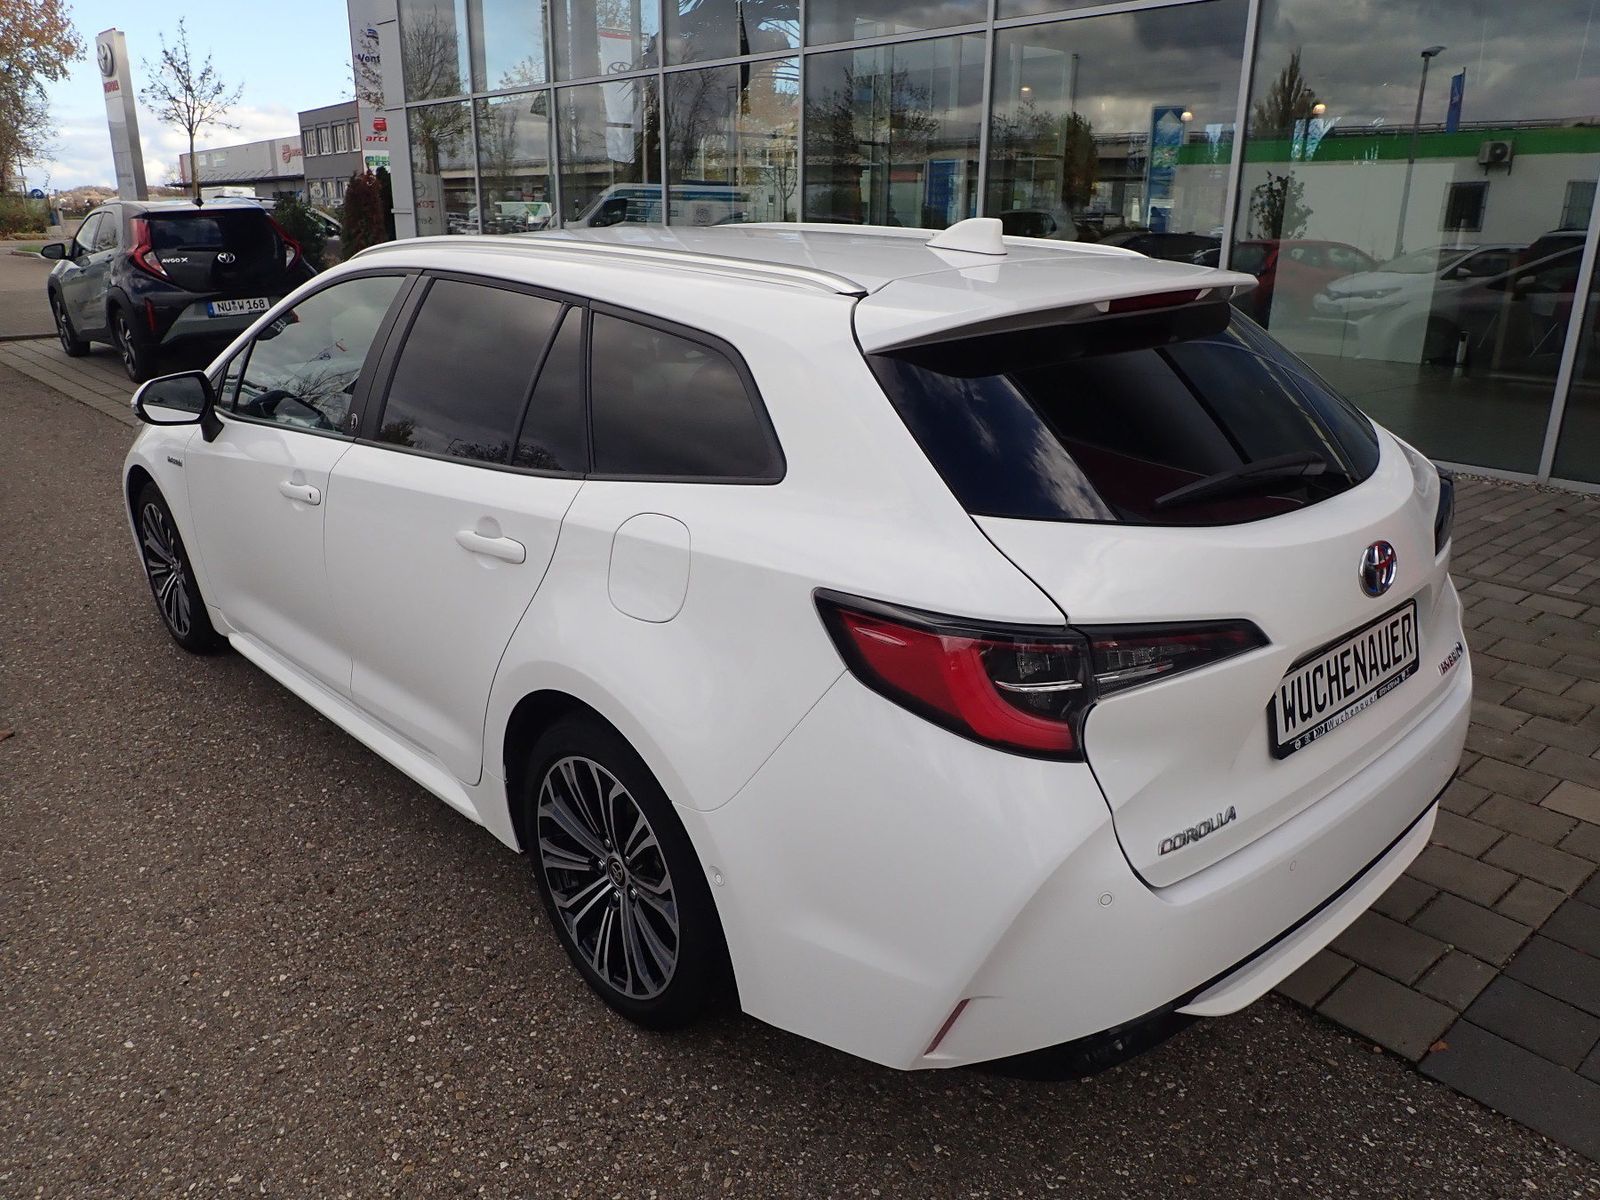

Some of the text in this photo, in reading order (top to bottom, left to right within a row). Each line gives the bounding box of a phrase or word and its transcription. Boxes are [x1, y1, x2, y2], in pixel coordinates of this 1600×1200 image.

[217, 303, 232, 312] NU
[246, 299, 265, 310] 168
[1281, 612, 1413, 734] WUCHENAUER
[1158, 805, 1237, 856] COROLLA
